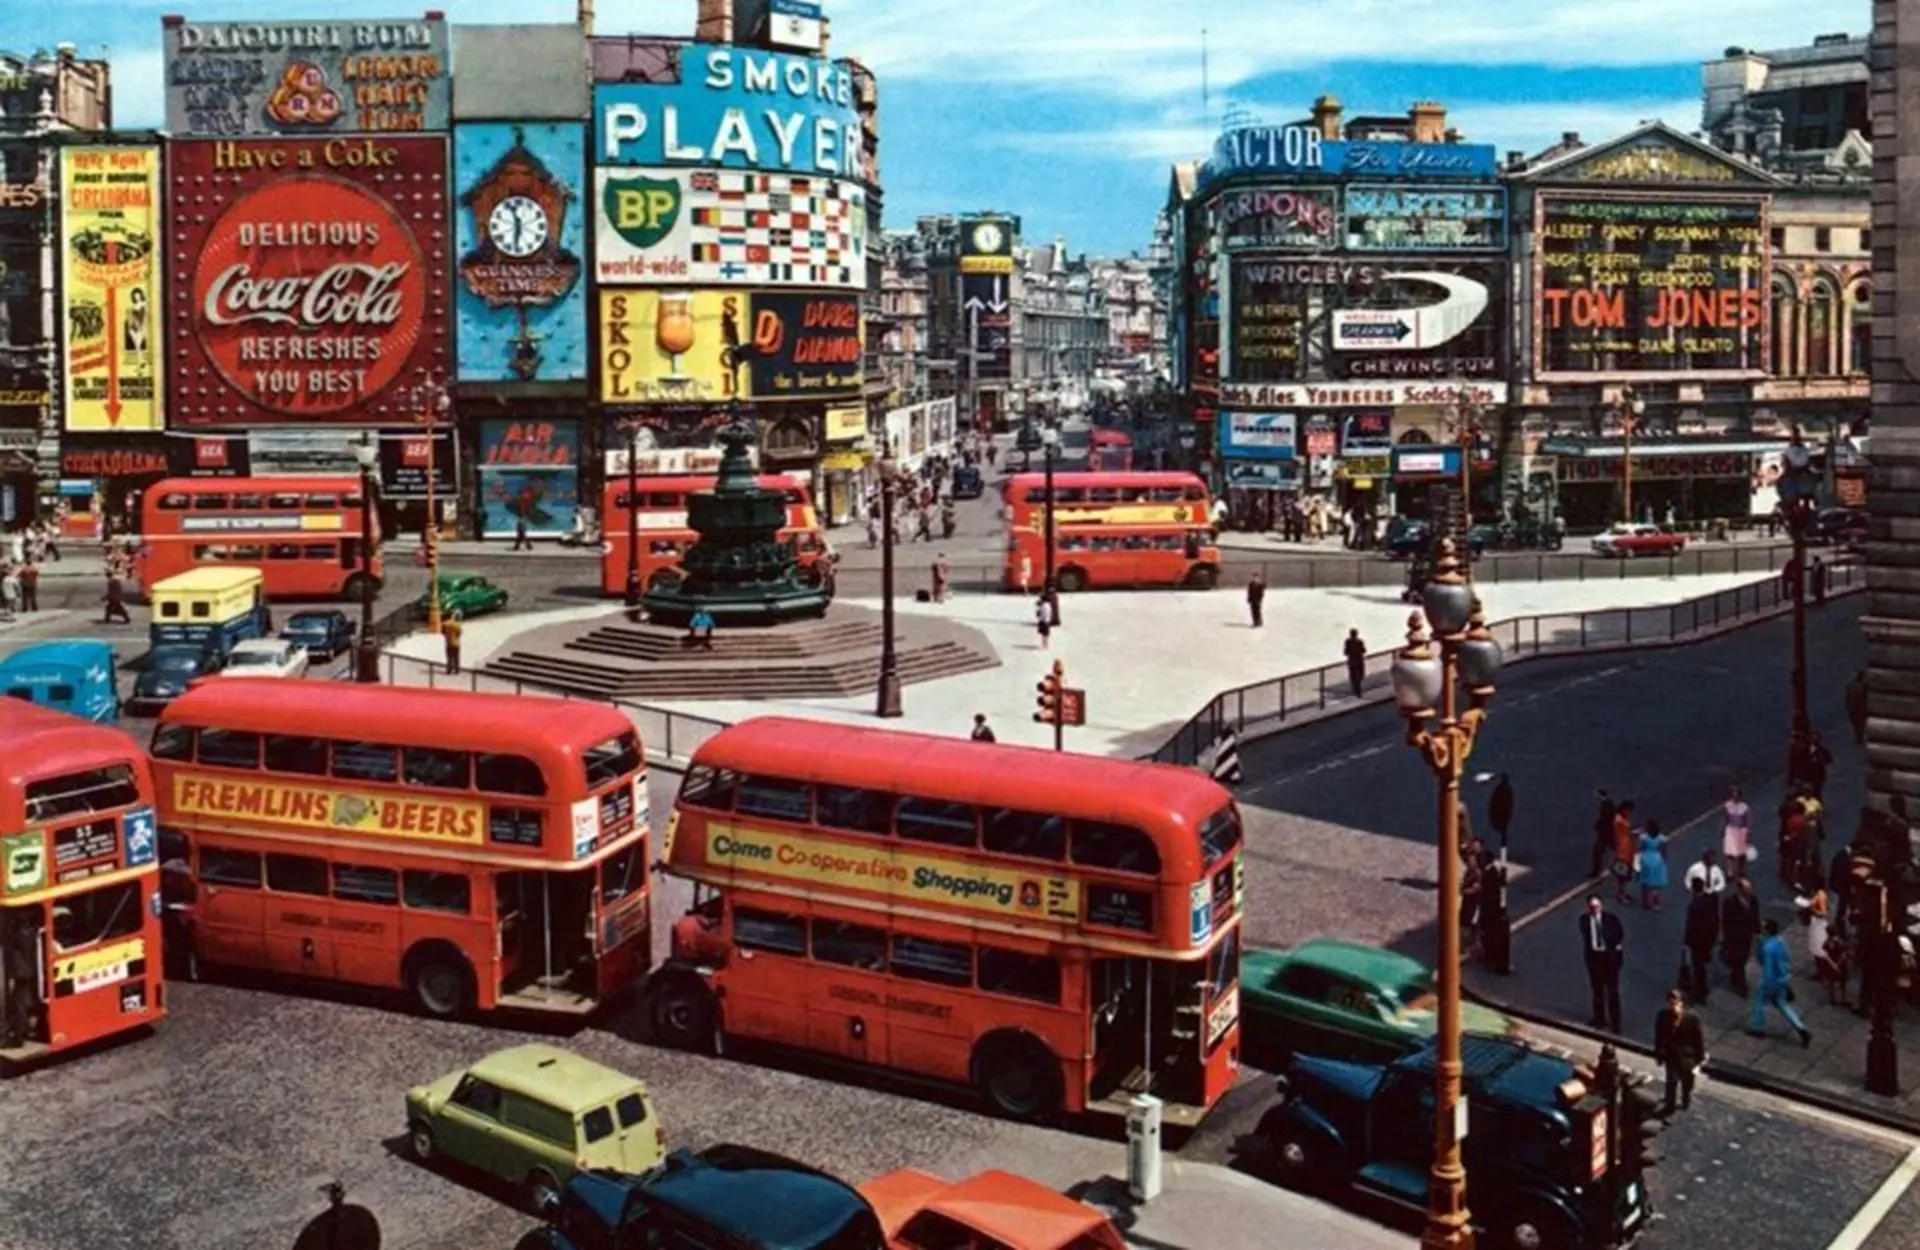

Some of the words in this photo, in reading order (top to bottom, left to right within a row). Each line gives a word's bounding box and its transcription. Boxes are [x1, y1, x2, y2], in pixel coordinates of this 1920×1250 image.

[180, 25, 340, 49] DAIQUIRI
[355, 24, 432, 48] RUM
[344, 56, 440, 79] LEMON
[705, 51, 853, 105] SMOKE
[214, 140, 287, 169] Have
[298, 147, 314, 166] a
[324, 138, 400, 167] Coke
[616, 188, 674, 229] BP
[238, 221, 382, 248] DELICIOUS
[1543, 223, 1593, 239] ALBERT
[1602, 224, 1646, 240] FINNEY
[1654, 226, 1720, 241] SUSANNAH
[600, 255, 688, 277] world-wide
[203, 260, 412, 329] Coca-Cola
[1544, 288, 1625, 329] TOM
[1645, 288, 1763, 329] JONES
[240, 336, 383, 362] REFRESHES
[608, 295, 632, 397] SKOL
[719, 296, 739, 397] SOL
[1638, 338, 1676, 354] DIANE
[1350, 357, 1446, 374] CHEWING
[1453, 356, 1495, 372] GUM
[254, 368, 300, 393] YOU
[308, 368, 367, 393] BEST
[1256, 386, 1296, 404] Ales
[1462, 385, 1495, 402] les
[504, 420, 556, 445] AIR
[485, 444, 569, 466] INDIA
[178, 779, 331, 823] FREMLINS
[379, 799, 478, 839] BEERS
[712, 833, 772, 862] Come
[912, 864, 1014, 906] Shopping
